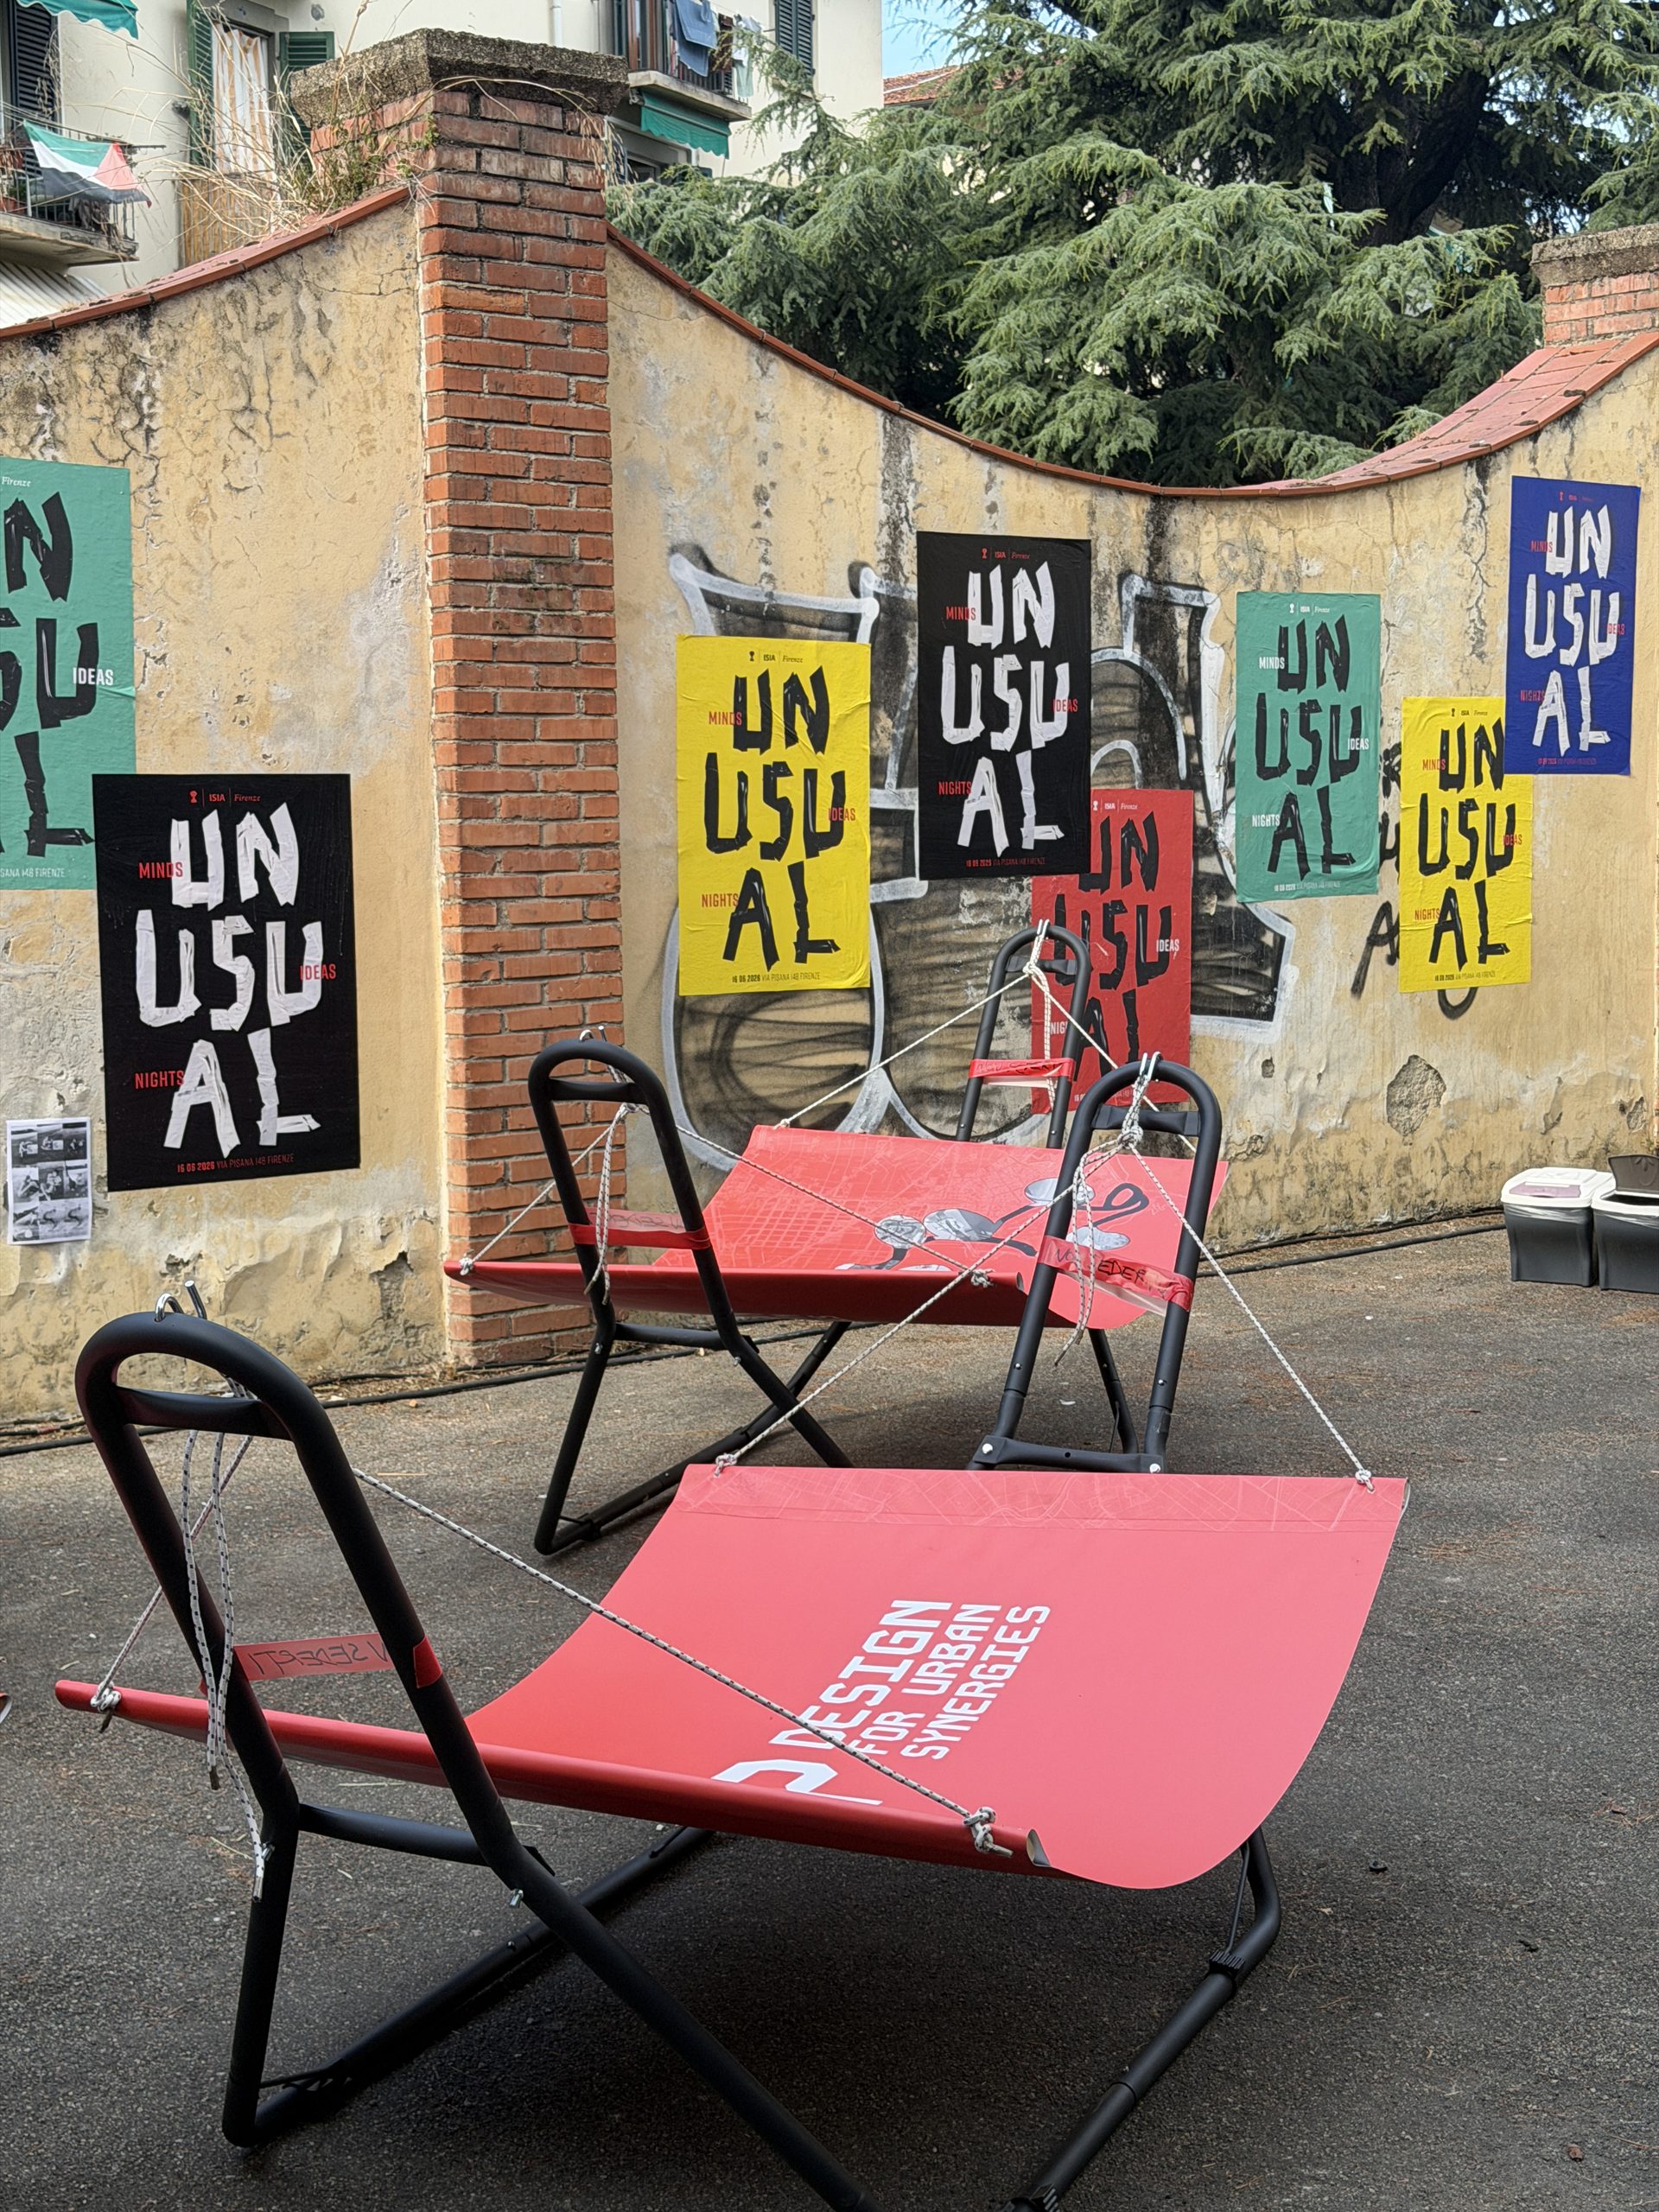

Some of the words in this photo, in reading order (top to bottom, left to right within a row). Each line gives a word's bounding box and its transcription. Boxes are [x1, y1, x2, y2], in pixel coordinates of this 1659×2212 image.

[2, 476, 31, 486] Firenze
[3, 492, 73, 601] N
[1530, 540, 1553, 553] MINDS
[1545, 505, 1611, 579] UN
[946, 607, 976, 620] MINDS
[968, 561, 1055, 650] UN
[1524, 574, 1620, 667] USU
[73, 667, 113, 685] IDEAS
[1259, 657, 1285, 670] MINDS
[1277, 614, 1350, 695] UN
[709, 711, 742, 726] MINDS
[733, 665, 830, 756] UN
[941, 645, 1070, 753] USU
[1052, 699, 1078, 712] IDEAS
[1532, 666, 1611, 757] AL
[1255, 693, 1362, 786] USU
[1348, 738, 1370, 750] IDEAS
[1439, 717, 1504, 794] UN
[938, 781, 972, 795] NIGHTS
[1422, 759, 1446, 771] MINDS
[13, 731, 95, 857] L
[704, 752, 846, 862] USU
[828, 807, 856, 821] IDEAS
[957, 750, 1065, 857] AL
[1252, 815, 1280, 827] NIGHTS
[1268, 785, 1356, 881] AL
[1418, 793, 1516, 881] USU
[1503, 834, 1522, 846] IDEAS
[0, 868, 20, 878] SANA
[35, 868, 65, 878] FIRENZE
[139, 861, 183, 879] MINDS
[170, 802, 299, 912] UN
[702, 893, 740, 907] NIGHTS
[722, 861, 841, 972] AL
[1414, 908, 1440, 920] NIGHTS
[1156, 939, 1179, 952] IDEAS
[1428, 879, 1510, 971] AL
[136, 909, 323, 1031] USU
[300, 963, 336, 981] IDEAS
[771, 972, 789, 982] PISANA
[800, 971, 821, 980] FIRENZE
[1050, 1020, 1068, 1035] NIG
[135, 1070, 184, 1090] NIGHTS
[163, 1027, 321, 1159] AL
[217, 1159, 227, 1168] VIA
[229, 1157, 254, 1168] PISANA
[268, 1153, 295, 1164] FIRENZE
[768, 1599, 953, 1750] DESIGN
[847, 1710, 926, 1756] FOR
[901, 1604, 1002, 1695] URBAN
[899, 1605, 1052, 1760] SYNERGIES
